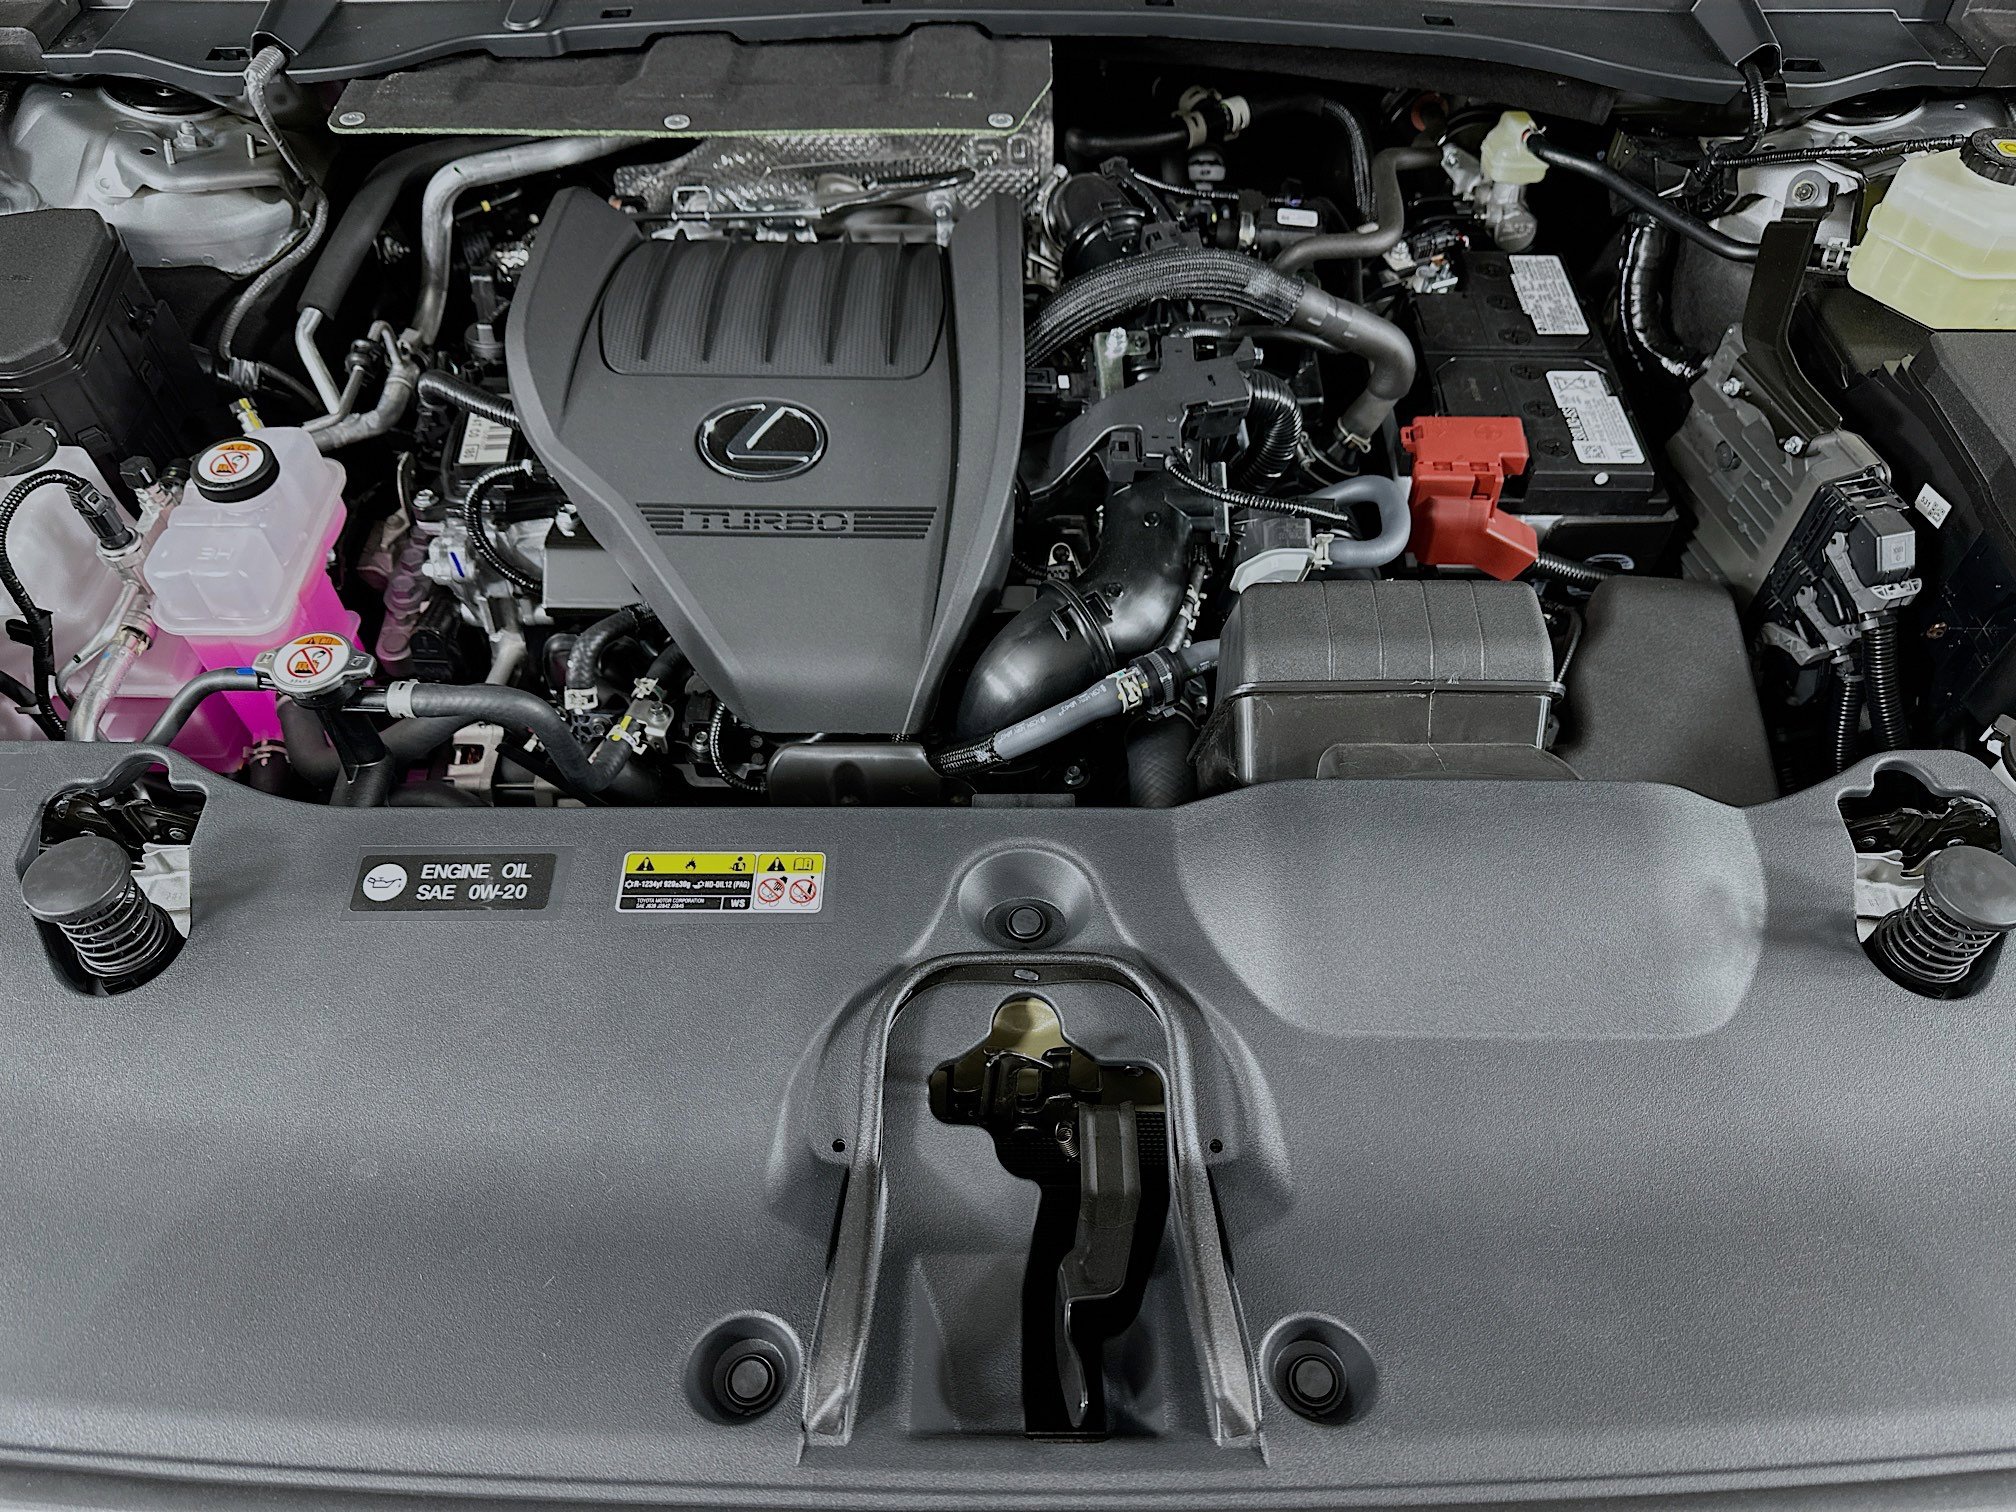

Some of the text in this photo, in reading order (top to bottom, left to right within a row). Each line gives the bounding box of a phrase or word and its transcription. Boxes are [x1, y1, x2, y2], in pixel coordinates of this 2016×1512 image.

[1920, 496, 1931, 508] 531
[687, 509, 849, 531] TURBO
[420, 863, 532, 880] ENGINE OIL
[416, 884, 528, 901] SAE 0W-20
[730, 898, 746, 908] WS
